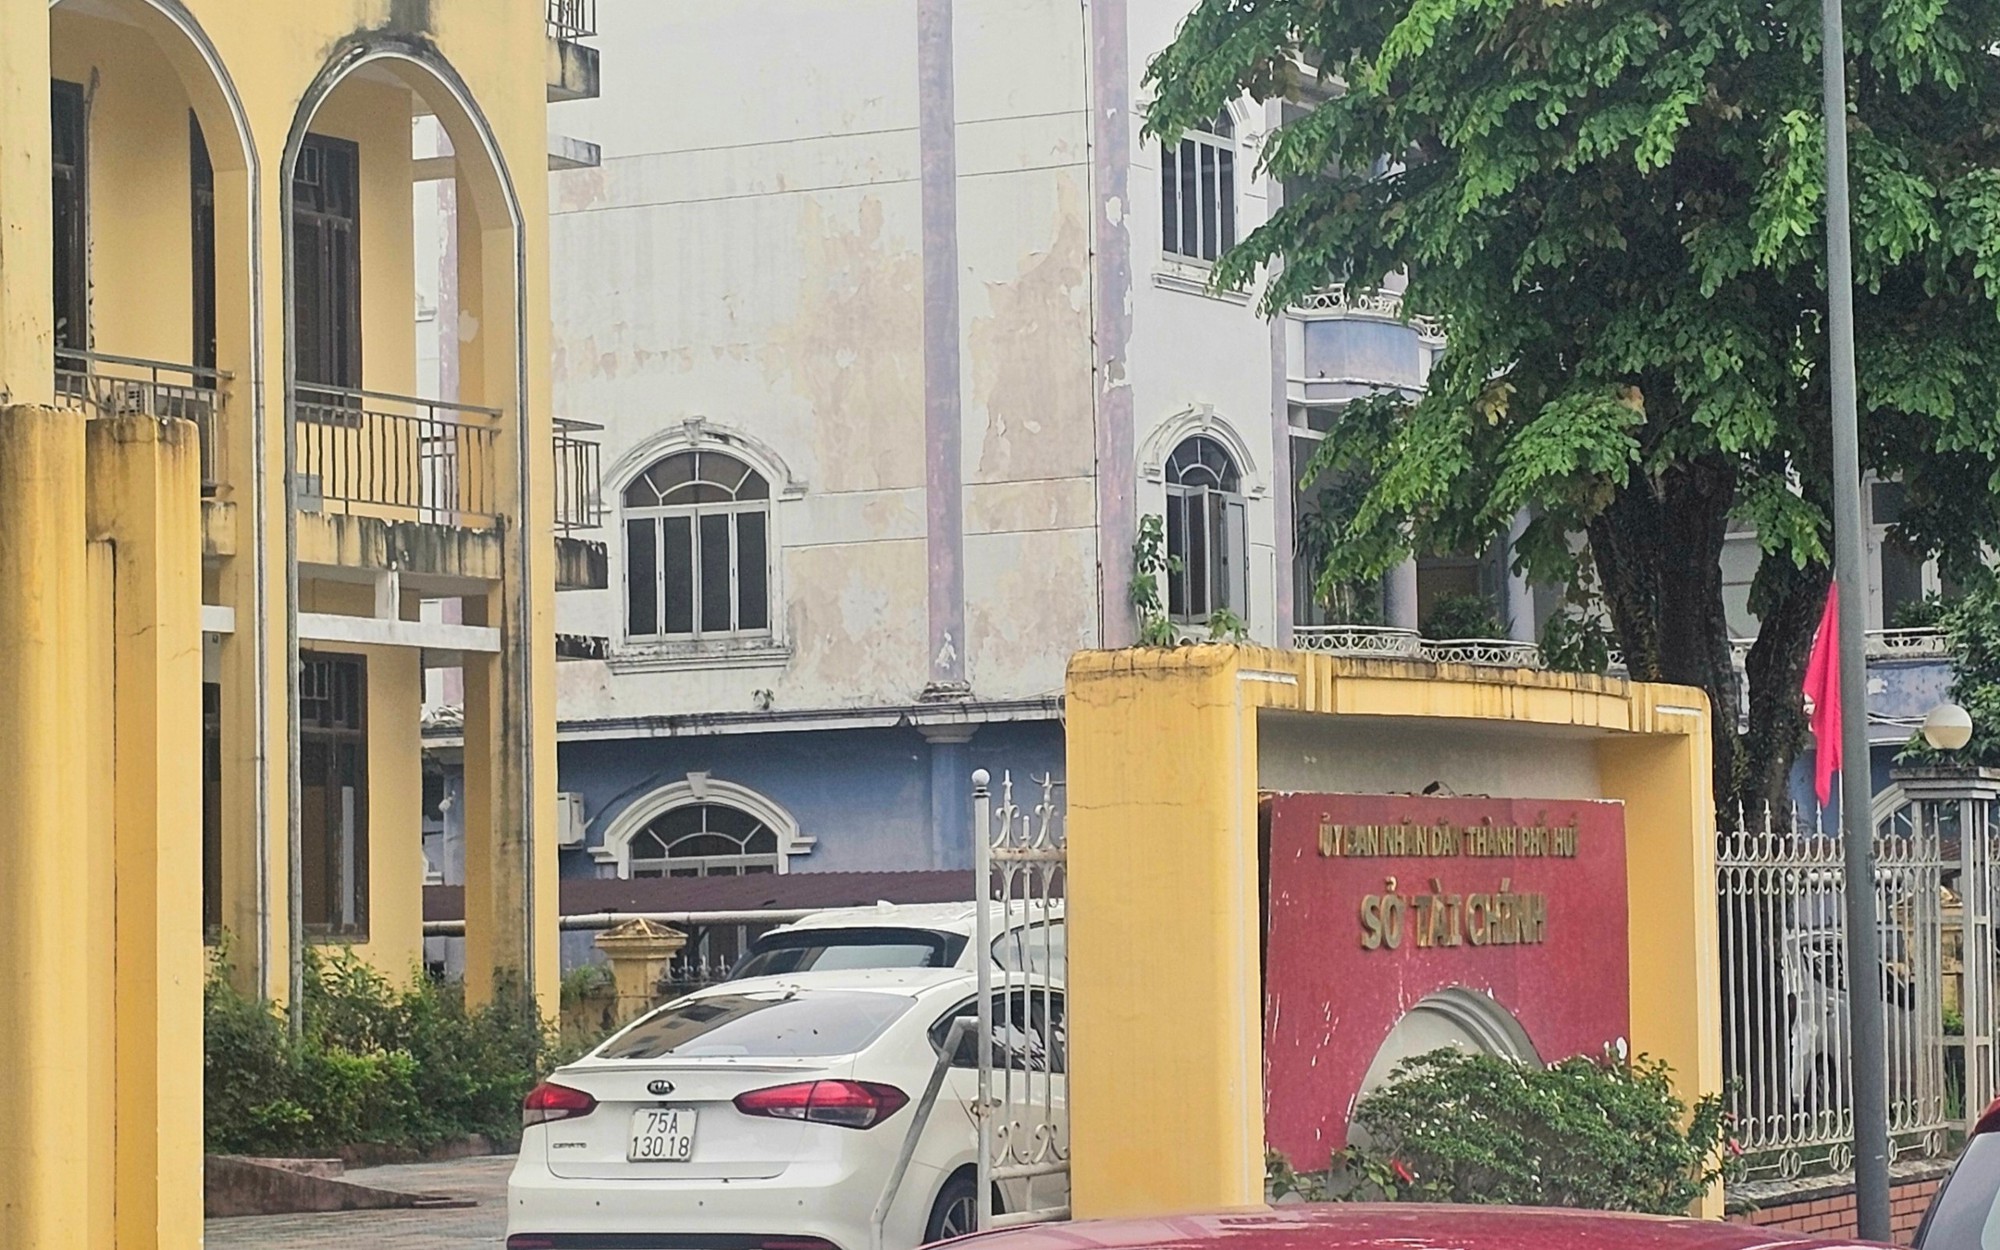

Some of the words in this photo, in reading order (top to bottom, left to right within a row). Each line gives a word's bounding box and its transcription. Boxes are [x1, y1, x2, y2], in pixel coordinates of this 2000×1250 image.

[1464, 816, 1518, 858] THÀNH
[1361, 875, 1405, 950] SỞ
[1411, 877, 1463, 948] TÀI
[1465, 877, 1547, 947] CHÍNH
[646, 1112, 678, 1134] 75A
[632, 1135, 690, 1157] 130.18
